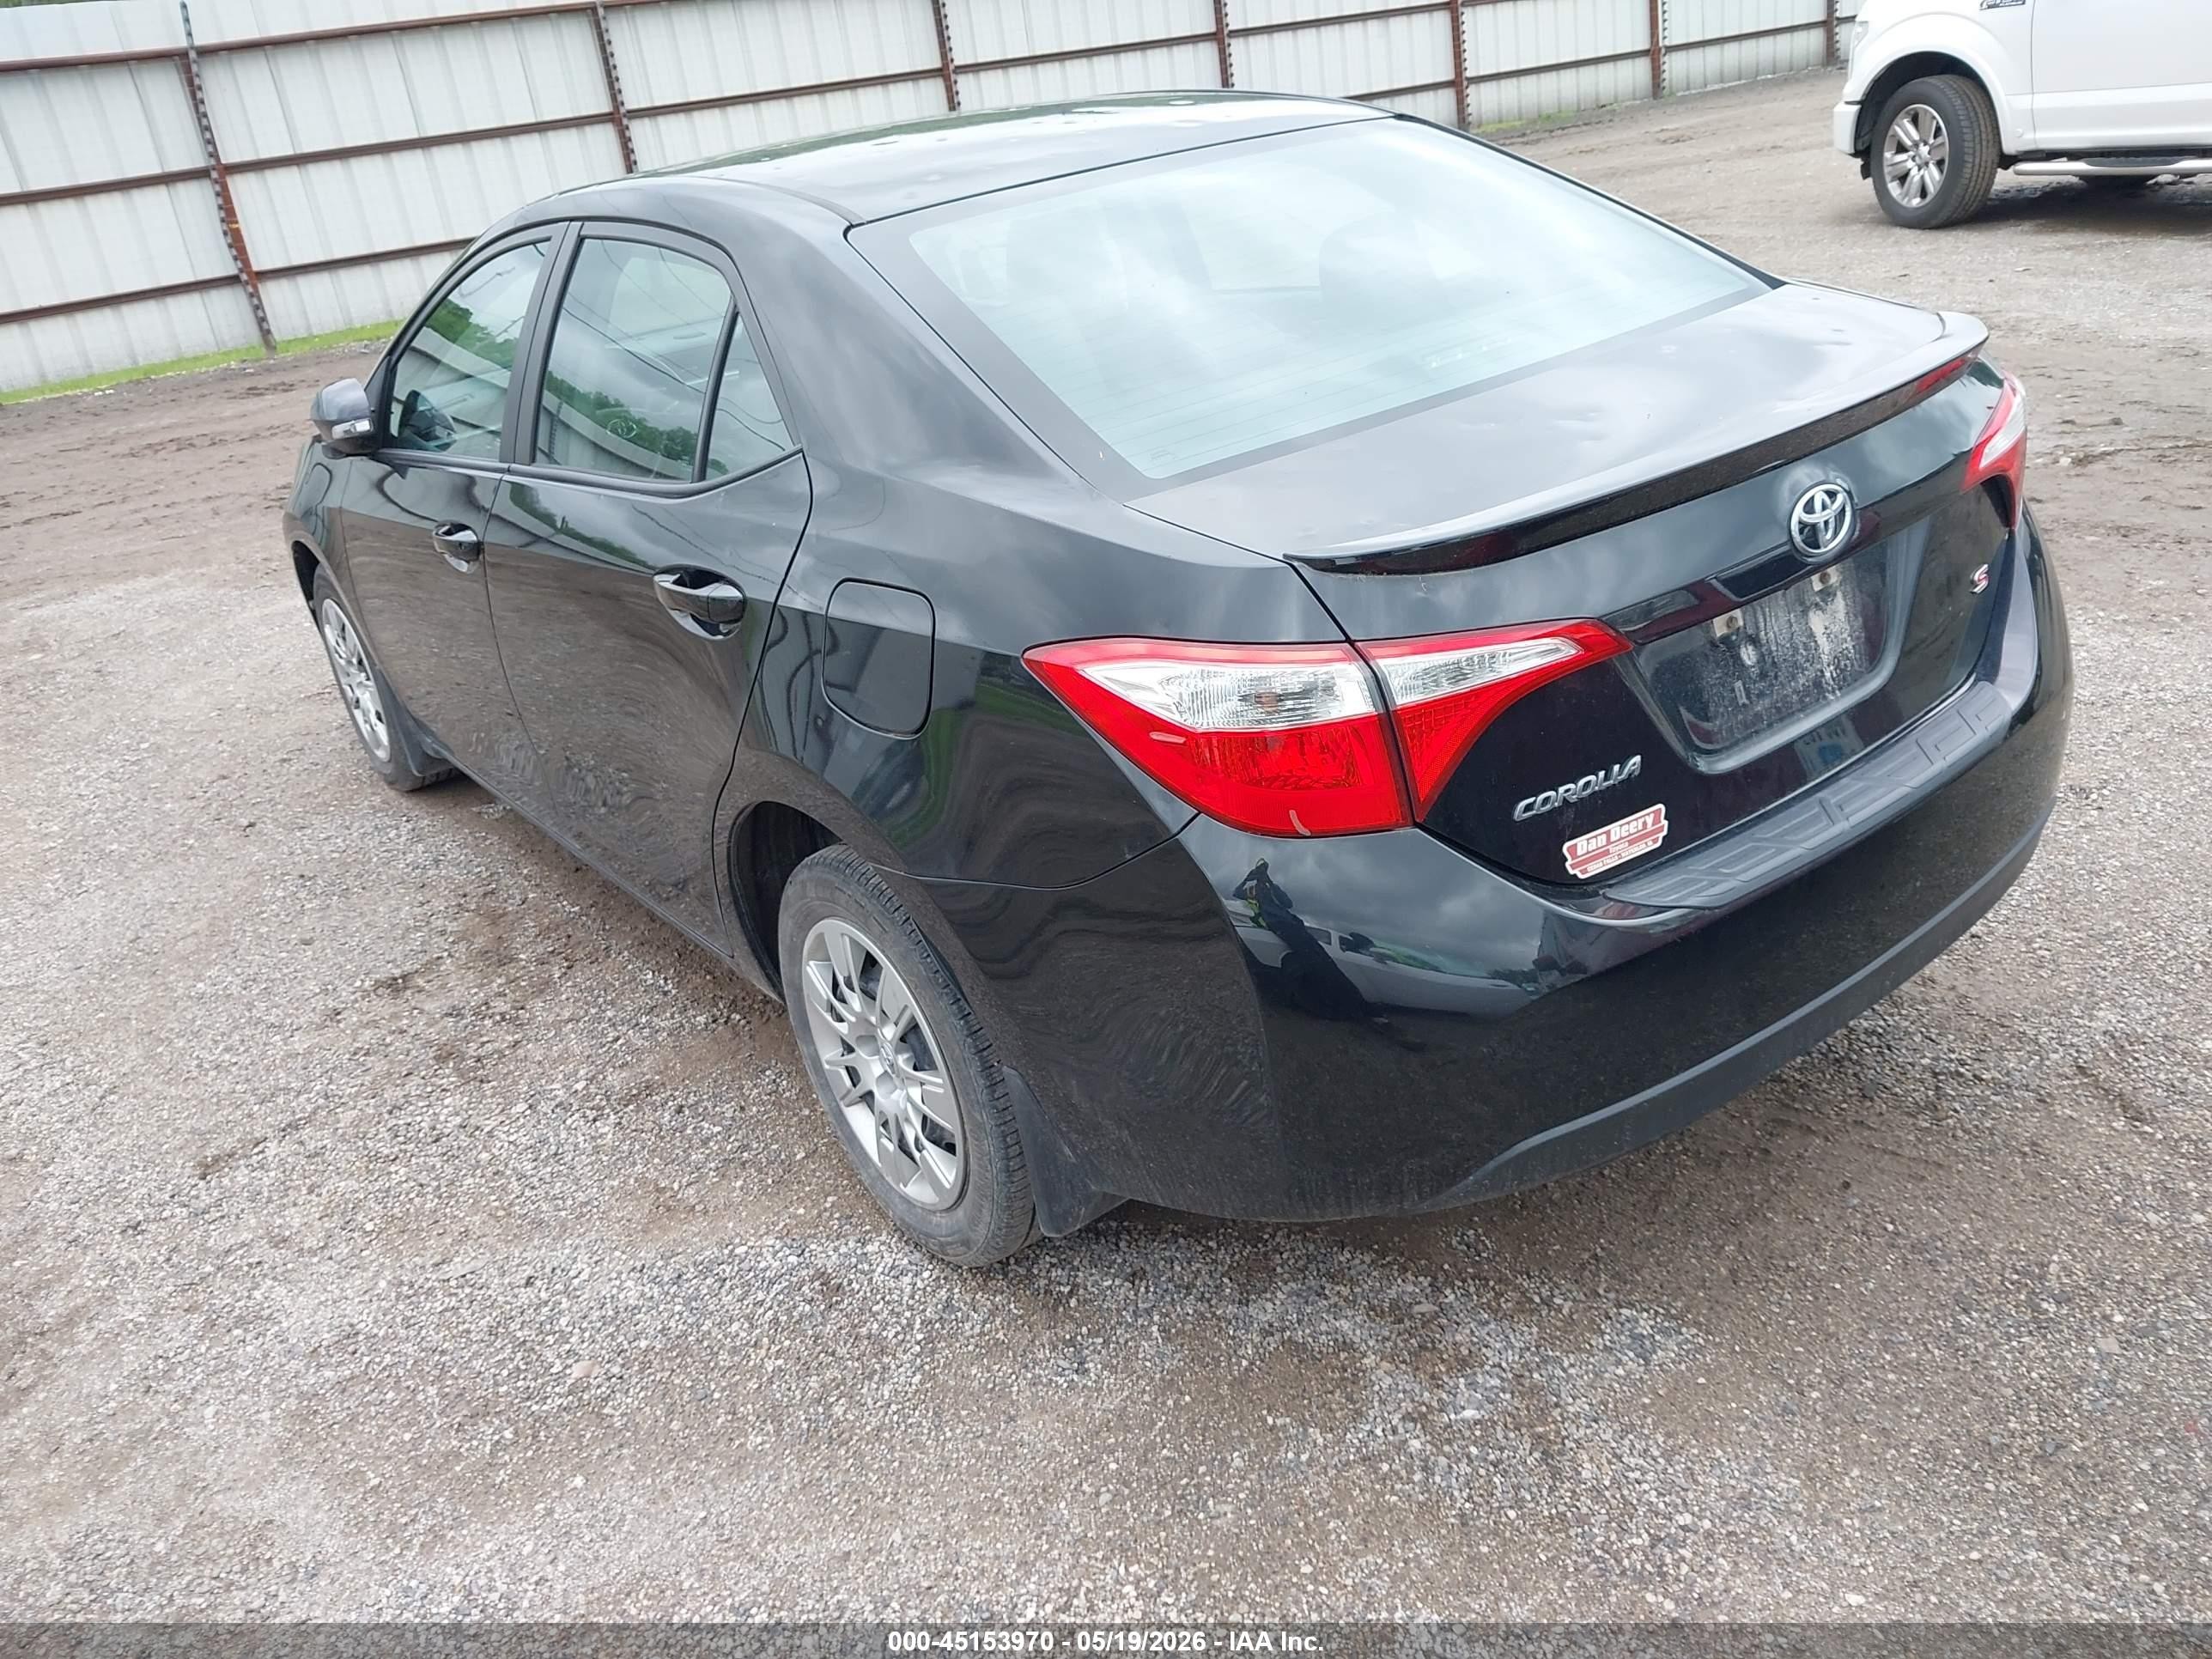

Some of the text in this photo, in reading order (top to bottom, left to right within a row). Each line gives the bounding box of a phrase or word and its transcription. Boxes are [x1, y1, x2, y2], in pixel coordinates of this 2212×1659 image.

[1970, 563, 1990, 594] S
[1513, 754, 1642, 822] COROLLA
[1576, 811, 1656, 857] Dan Deery
